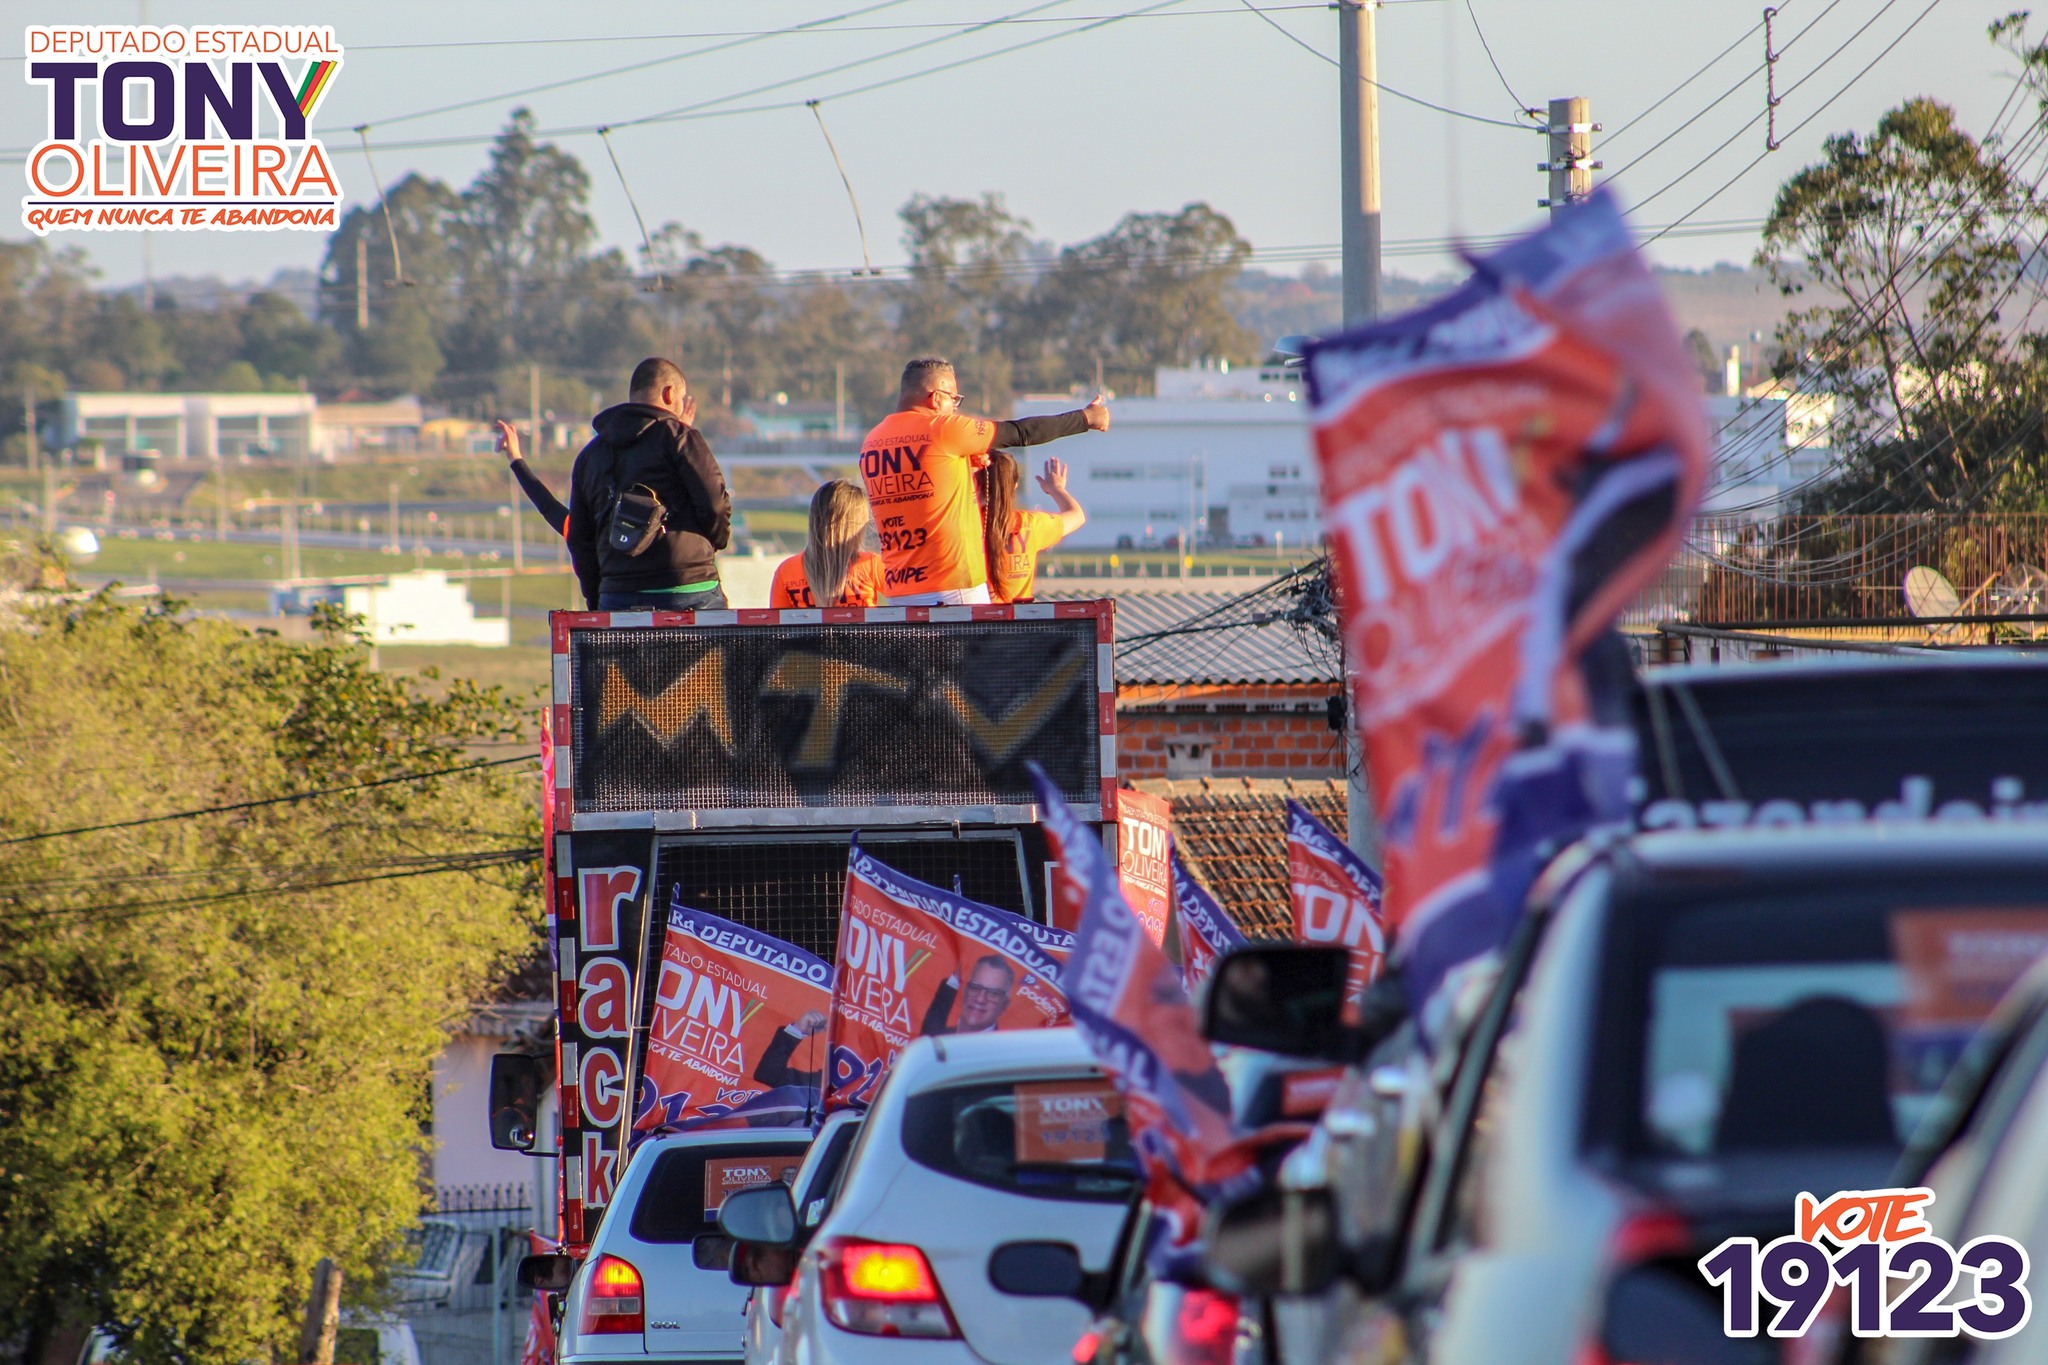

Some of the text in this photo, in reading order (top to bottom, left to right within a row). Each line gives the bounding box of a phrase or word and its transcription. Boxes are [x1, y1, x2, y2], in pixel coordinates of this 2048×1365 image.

[882, 516, 906, 528] VOTE
[885, 566, 929, 589] QUIPE
[871, 908, 938, 949] ESTADUAL
[1182, 894, 1231, 948] DEPUT
[700, 926, 827, 982] DEPUTADO
[845, 915, 932, 994] ONY
[656, 960, 765, 1039] ONY
[706, 962, 769, 1000] ESTADUAL
[649, 1006, 745, 1074] IVEIRA
[682, 1058, 740, 1087] ABANDONA
[715, 1086, 763, 1104] VOT
[722, 1168, 769, 1178] TONY
[650, 1320, 681, 1329] GOL
